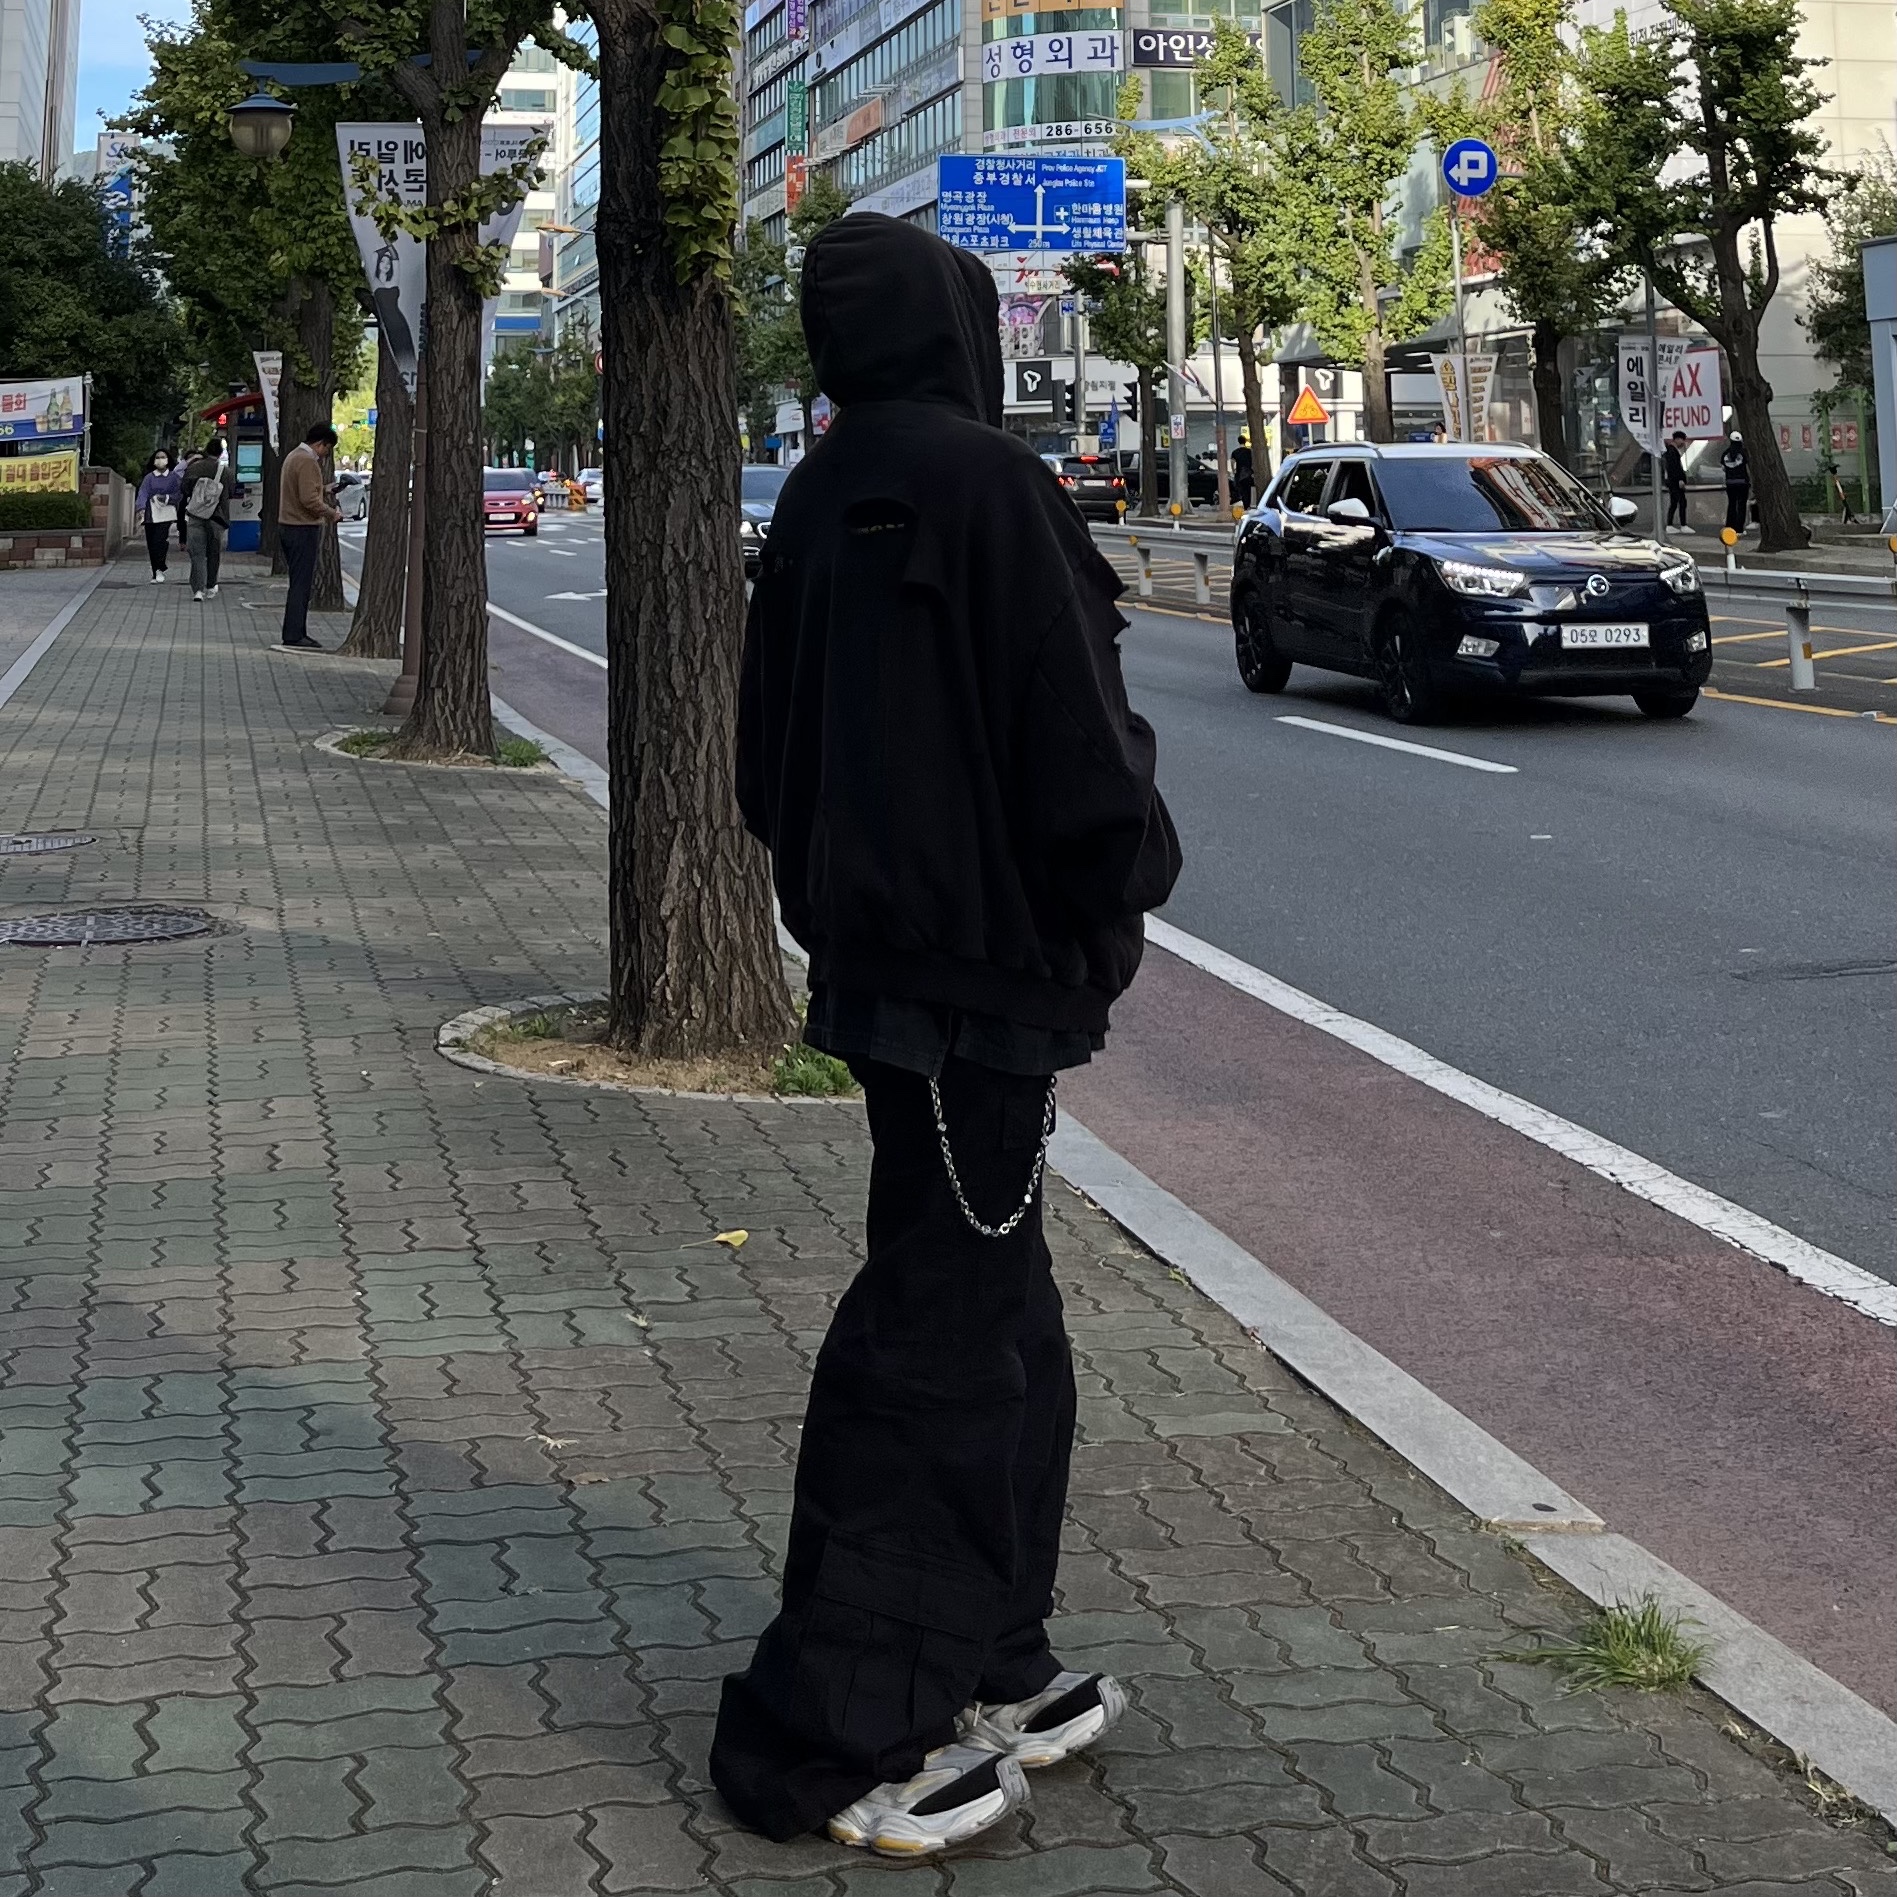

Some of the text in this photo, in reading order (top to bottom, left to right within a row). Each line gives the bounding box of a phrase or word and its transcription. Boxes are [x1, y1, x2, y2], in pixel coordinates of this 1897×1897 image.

[985, 35, 1119, 79] 성형외과
[1046, 122, 1121, 137] 286-656
[974, 158, 1036, 171] 경찰청사거리
[1056, 163, 1073, 172] Police
[1074, 164, 1095, 174] Agency
[972, 172, 1036, 186] 중부경찰서
[1064, 178, 1083, 187] Police
[941, 190, 987, 204] 명곡광장
[977, 203, 995, 212] Plaza
[1071, 202, 1124, 216] 한마음병원
[941, 212, 1014, 226] 창원광장(시청)
[973, 225, 990, 234] Plaza
[1071, 226, 1124, 240] 생활체육관
[1672, 362, 1703, 399] AX
[1626, 355, 1647, 428] 에일리
[2, 392, 26, 413] 물회
[1664, 405, 1711, 428] EFUND
[5, 463, 27, 483] 절대
[1604, 627, 1641, 643] 0293
